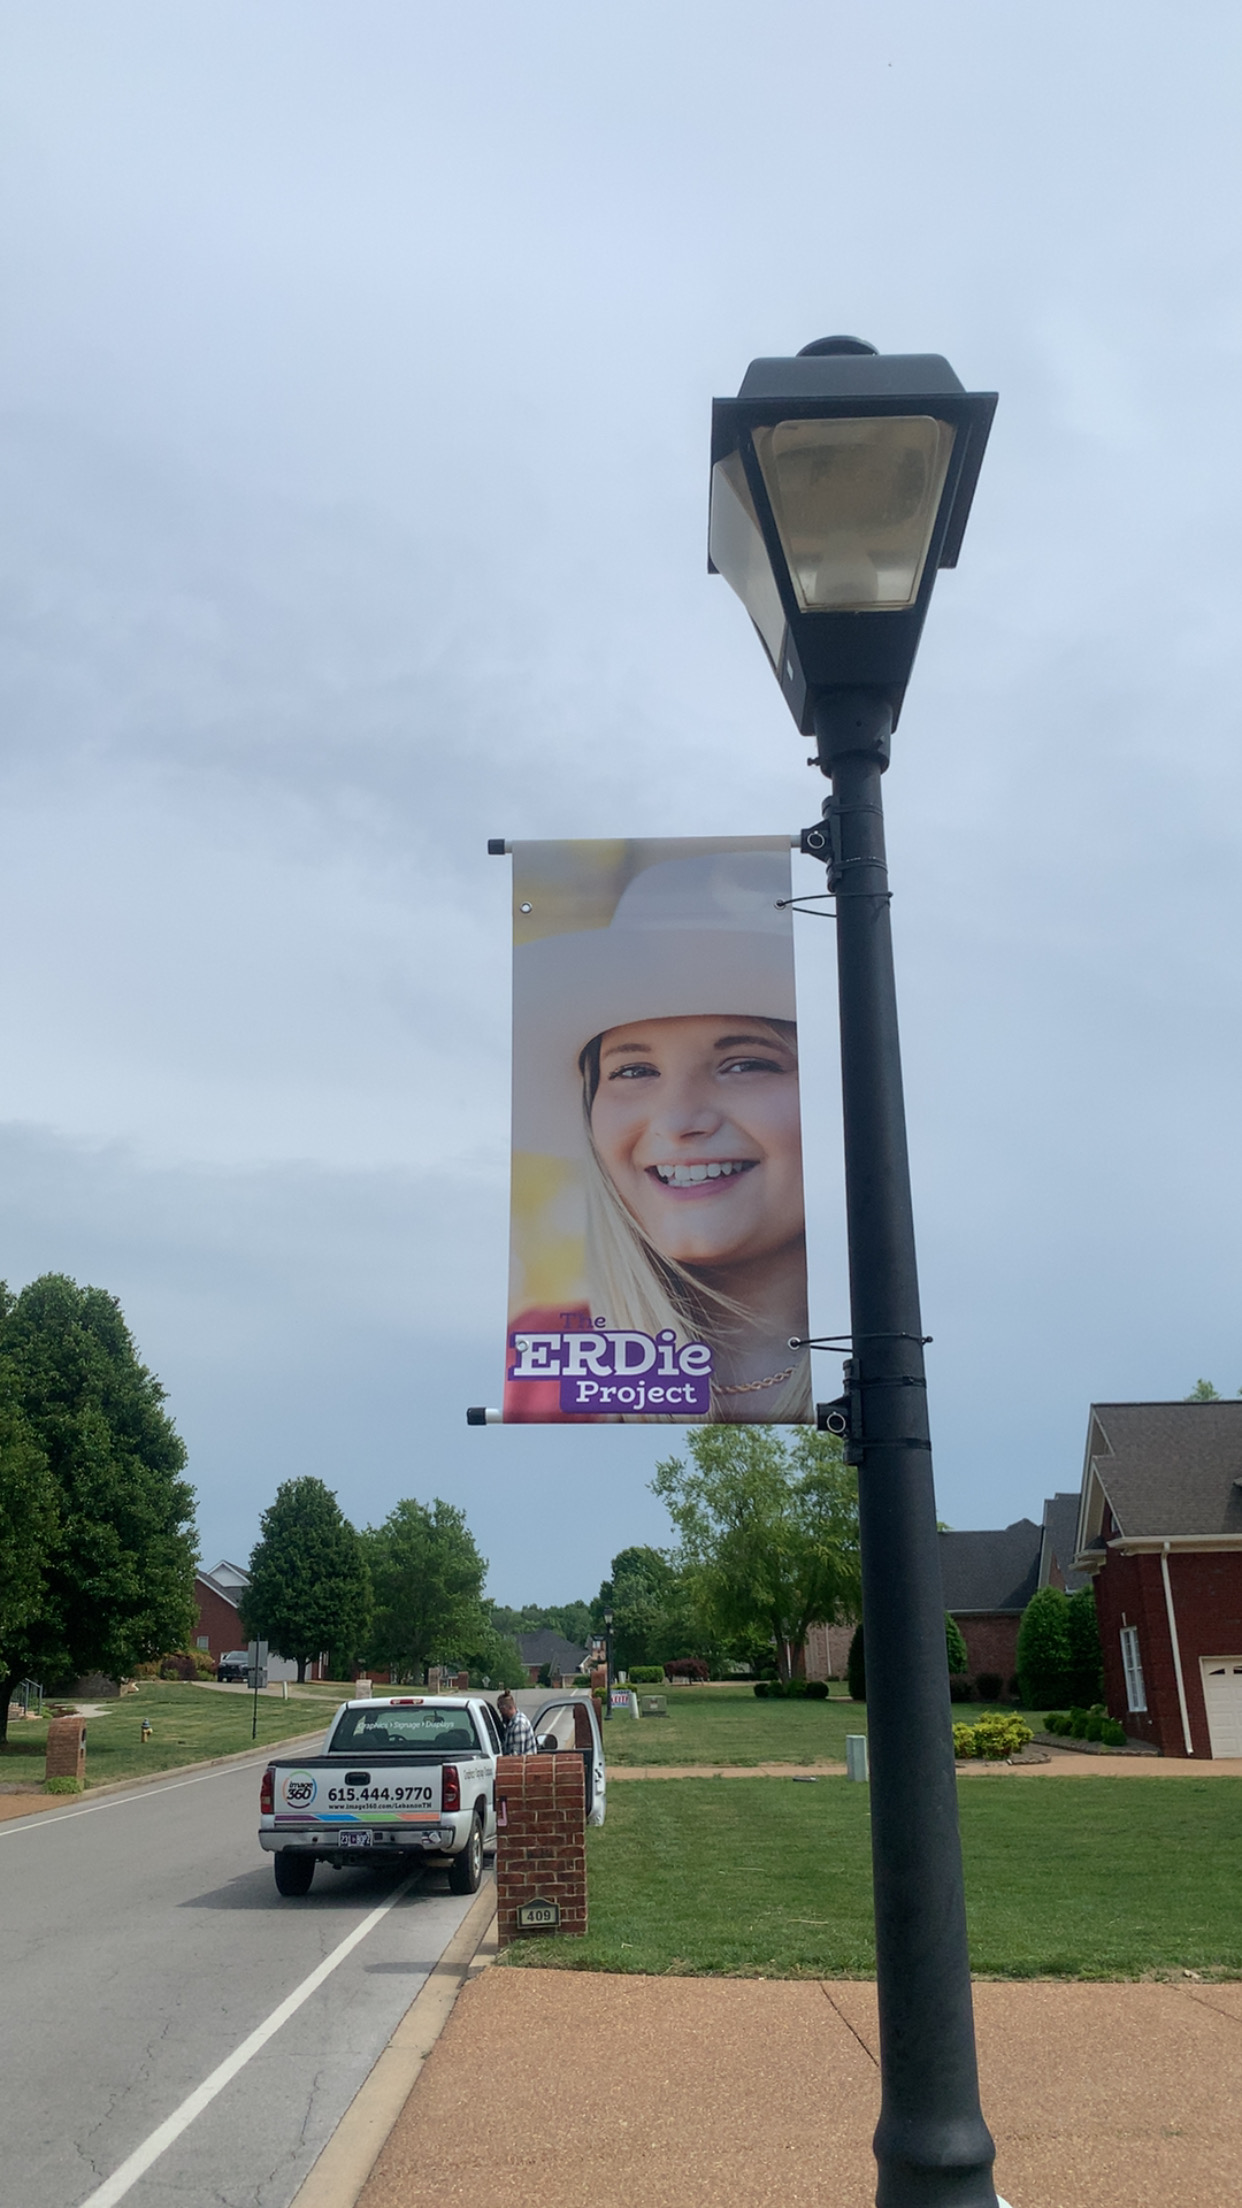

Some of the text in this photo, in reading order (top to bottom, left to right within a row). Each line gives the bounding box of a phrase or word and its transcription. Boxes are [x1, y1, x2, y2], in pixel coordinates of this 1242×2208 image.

[560, 1313, 606, 1329] The
[513, 1331, 712, 1376] ERDie
[576, 1381, 697, 1410] Project
[393, 1721, 420, 1730] Signage
[425, 1720, 455, 1729] Displays
[286, 1788, 312, 1800] 360
[328, 1787, 432, 1801] 615.444.9770
[527, 1910, 551, 1921] 409
